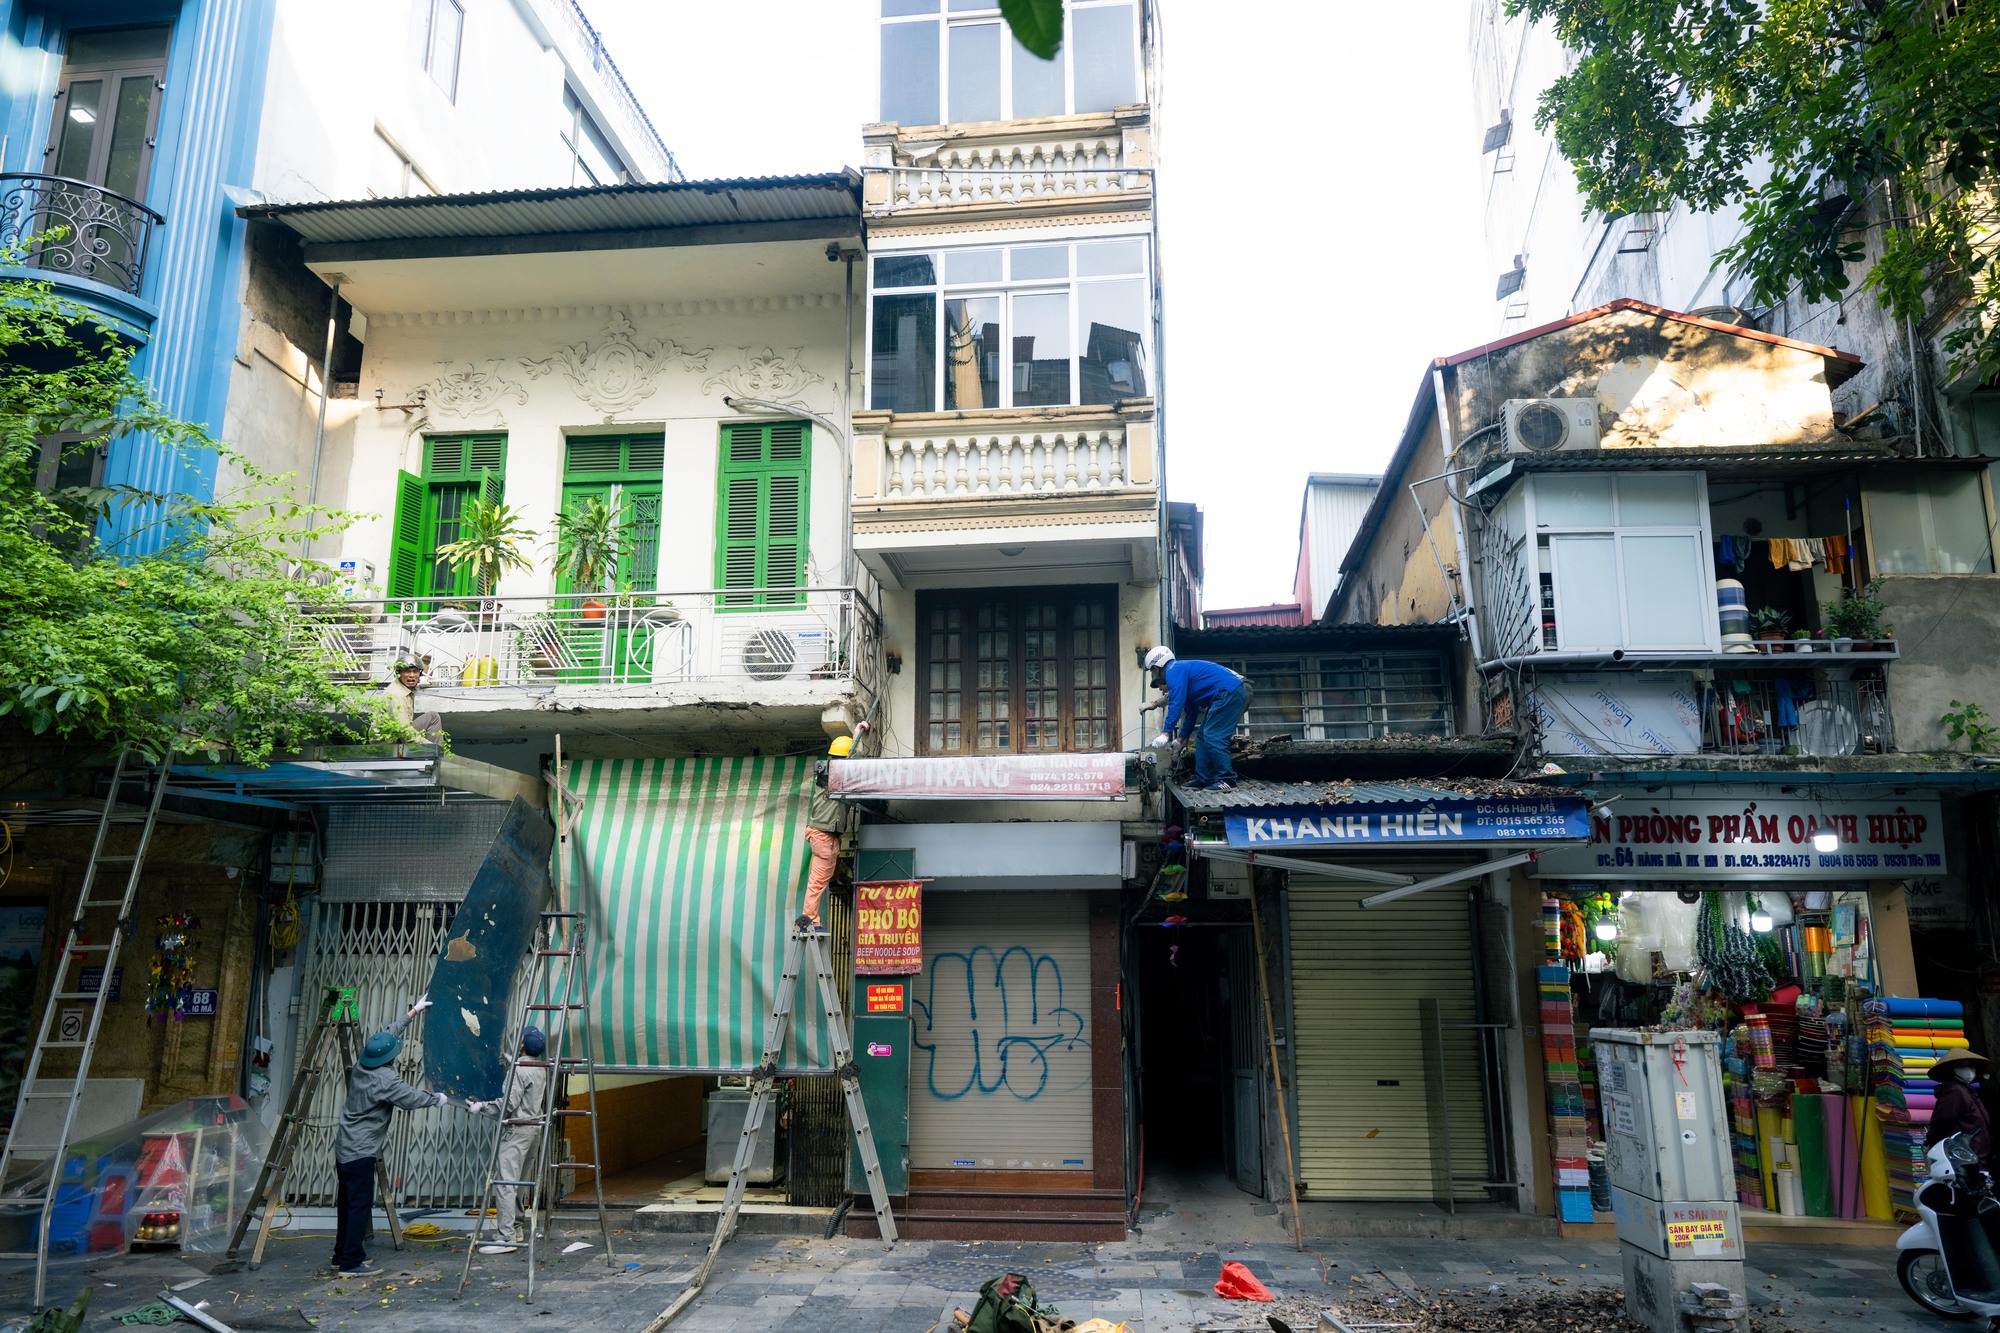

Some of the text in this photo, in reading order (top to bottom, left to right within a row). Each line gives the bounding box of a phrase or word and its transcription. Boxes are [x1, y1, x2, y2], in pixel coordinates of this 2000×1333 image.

[1578, 418, 1592, 427] LG
[843, 758, 1010, 788] MINH TRANG
[1476, 803, 1556, 815] ĐC: 66 Hàng Mã
[1246, 803, 1463, 842] KHANH HIỀN
[1476, 815, 1565, 826] ĐT: 0915 565 365
[1617, 806, 1702, 844] PHÒNG
[1707, 801, 1781, 844] PHẨM
[1787, 814, 1859, 845] OANH
[1866, 806, 1927, 850] HIỆP
[1497, 827, 1566, 837] 083 911 5593
[1637, 852, 1664, 867] HÀNG
[1665, 852, 1683, 867] MÃ
[1685, 854, 1700, 867] HK
[1704, 854, 1718, 867] HN
[1819, 854, 1841, 867] 0904
[1843, 854, 1854, 867] 66
[1856, 854, 1878, 867] 5858
[860, 884, 919, 900] TƯ LÙN
[858, 902, 919, 930] PHỞ BÒ
[858, 929, 919, 945] GIA TRUYỀN
[857, 946, 921, 957] BEEF NOODLE SOUP
[192, 992, 210, 1005] 68
[200, 1004, 212, 1013] MÃ
[1674, 1210, 1685, 1220] XE
[1688, 1207, 1708, 1220] SÂN
[1669, 1221, 1723, 1234] SÂN BAY GIÁ RẺ
